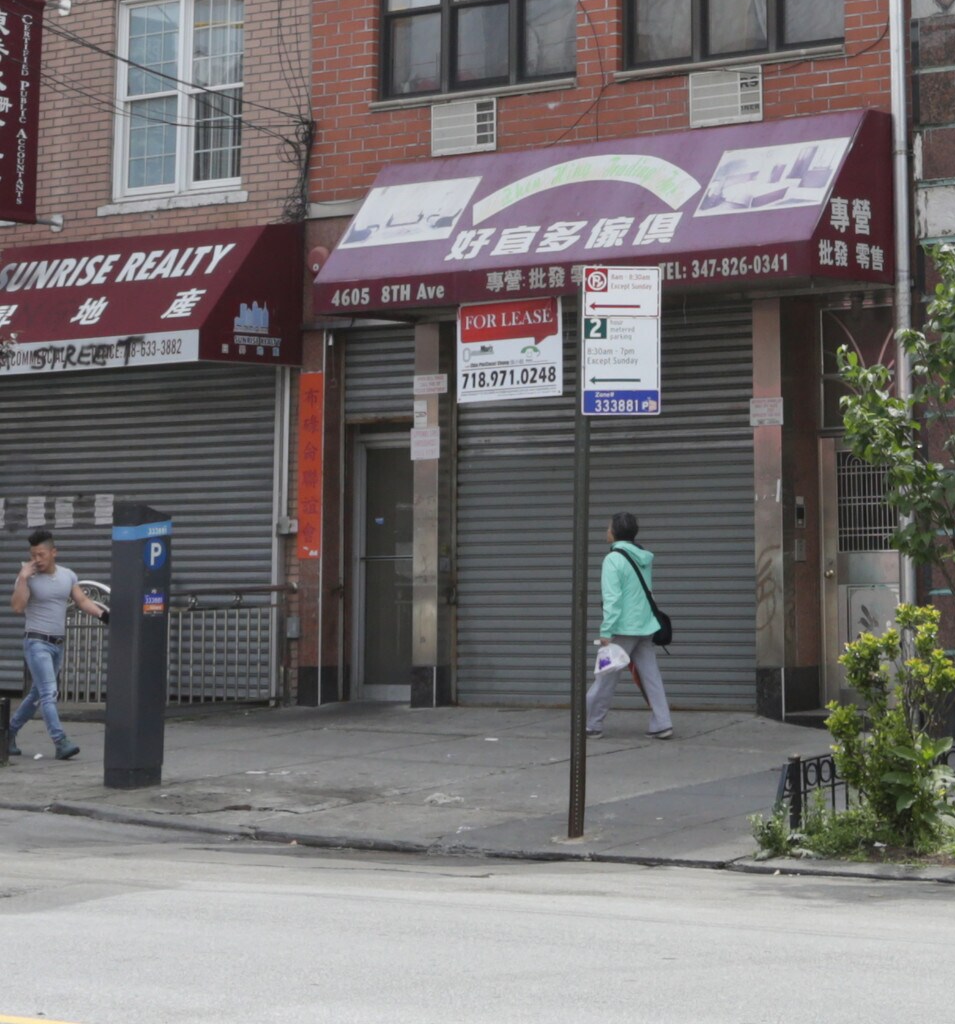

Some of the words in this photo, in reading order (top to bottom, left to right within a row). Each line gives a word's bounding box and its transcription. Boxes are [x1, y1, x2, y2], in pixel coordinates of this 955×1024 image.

[21, 14, 33, 76] CERTIFIED
[18, 80, 30, 124] PUBLIC
[15, 128, 28, 205] ACCOUNTANTS
[444, 212, 683, 261] 好宜多傢俱
[0, 254, 121, 292] SUNRISE
[115, 243, 236, 283] REALTY
[658, 262, 687, 281] TEL:
[691, 253, 788, 278] 347-826-0341
[331, 287, 370, 306] 4605
[381, 284, 411, 303] 8TH
[416, 283, 445, 300] Ave
[465, 313, 497, 330] FOR
[501, 308, 553, 327] LEASE
[589, 319, 602, 338] 2
[31, 335, 145, 370] STREET
[587, 358, 611, 367] Except
[613, 357, 638, 366] Sunday
[621, 348, 635, 356] 7pm
[462, 366, 556, 389] 718.971.0248
[595, 400, 638, 412] 333881
[150, 542, 162, 566] P
